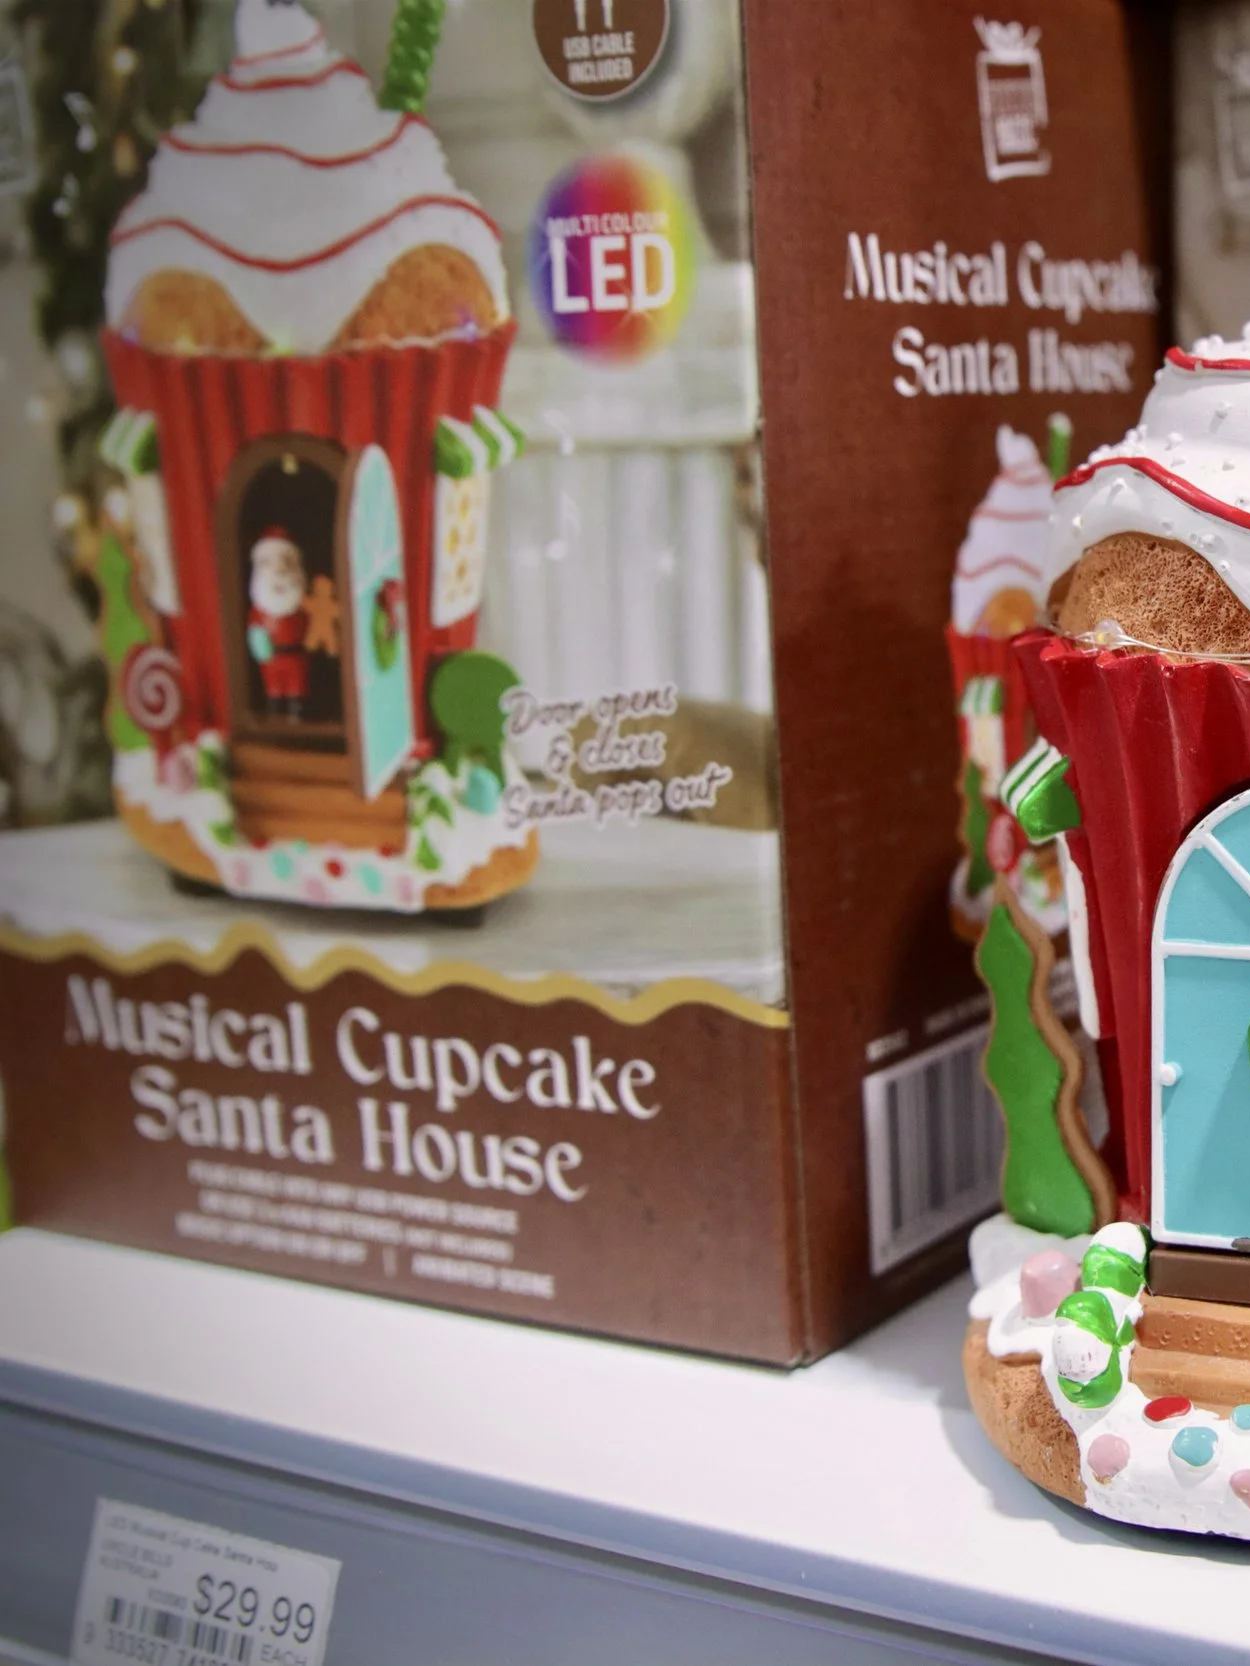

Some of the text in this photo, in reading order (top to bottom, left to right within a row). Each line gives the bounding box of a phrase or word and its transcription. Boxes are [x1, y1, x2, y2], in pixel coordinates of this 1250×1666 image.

[568, 57, 633, 83] INCLUDED
[591, 31, 635, 57] CABLE
[549, 233, 676, 314] LED
[843, 231, 1008, 306] Musical
[892, 325, 1135, 398] Santa House
[502, 685, 676, 735] Door opens
[585, 726, 664, 768] closes
[502, 764, 729, 830] Santa pops out
[65, 973, 662, 1120] Musical Cupcake
[130, 1064, 336, 1165] Santa
[357, 1097, 589, 1202] House
[193, 1573, 316, 1644] $29.99
[261, 1643, 308, 1666] EACH
